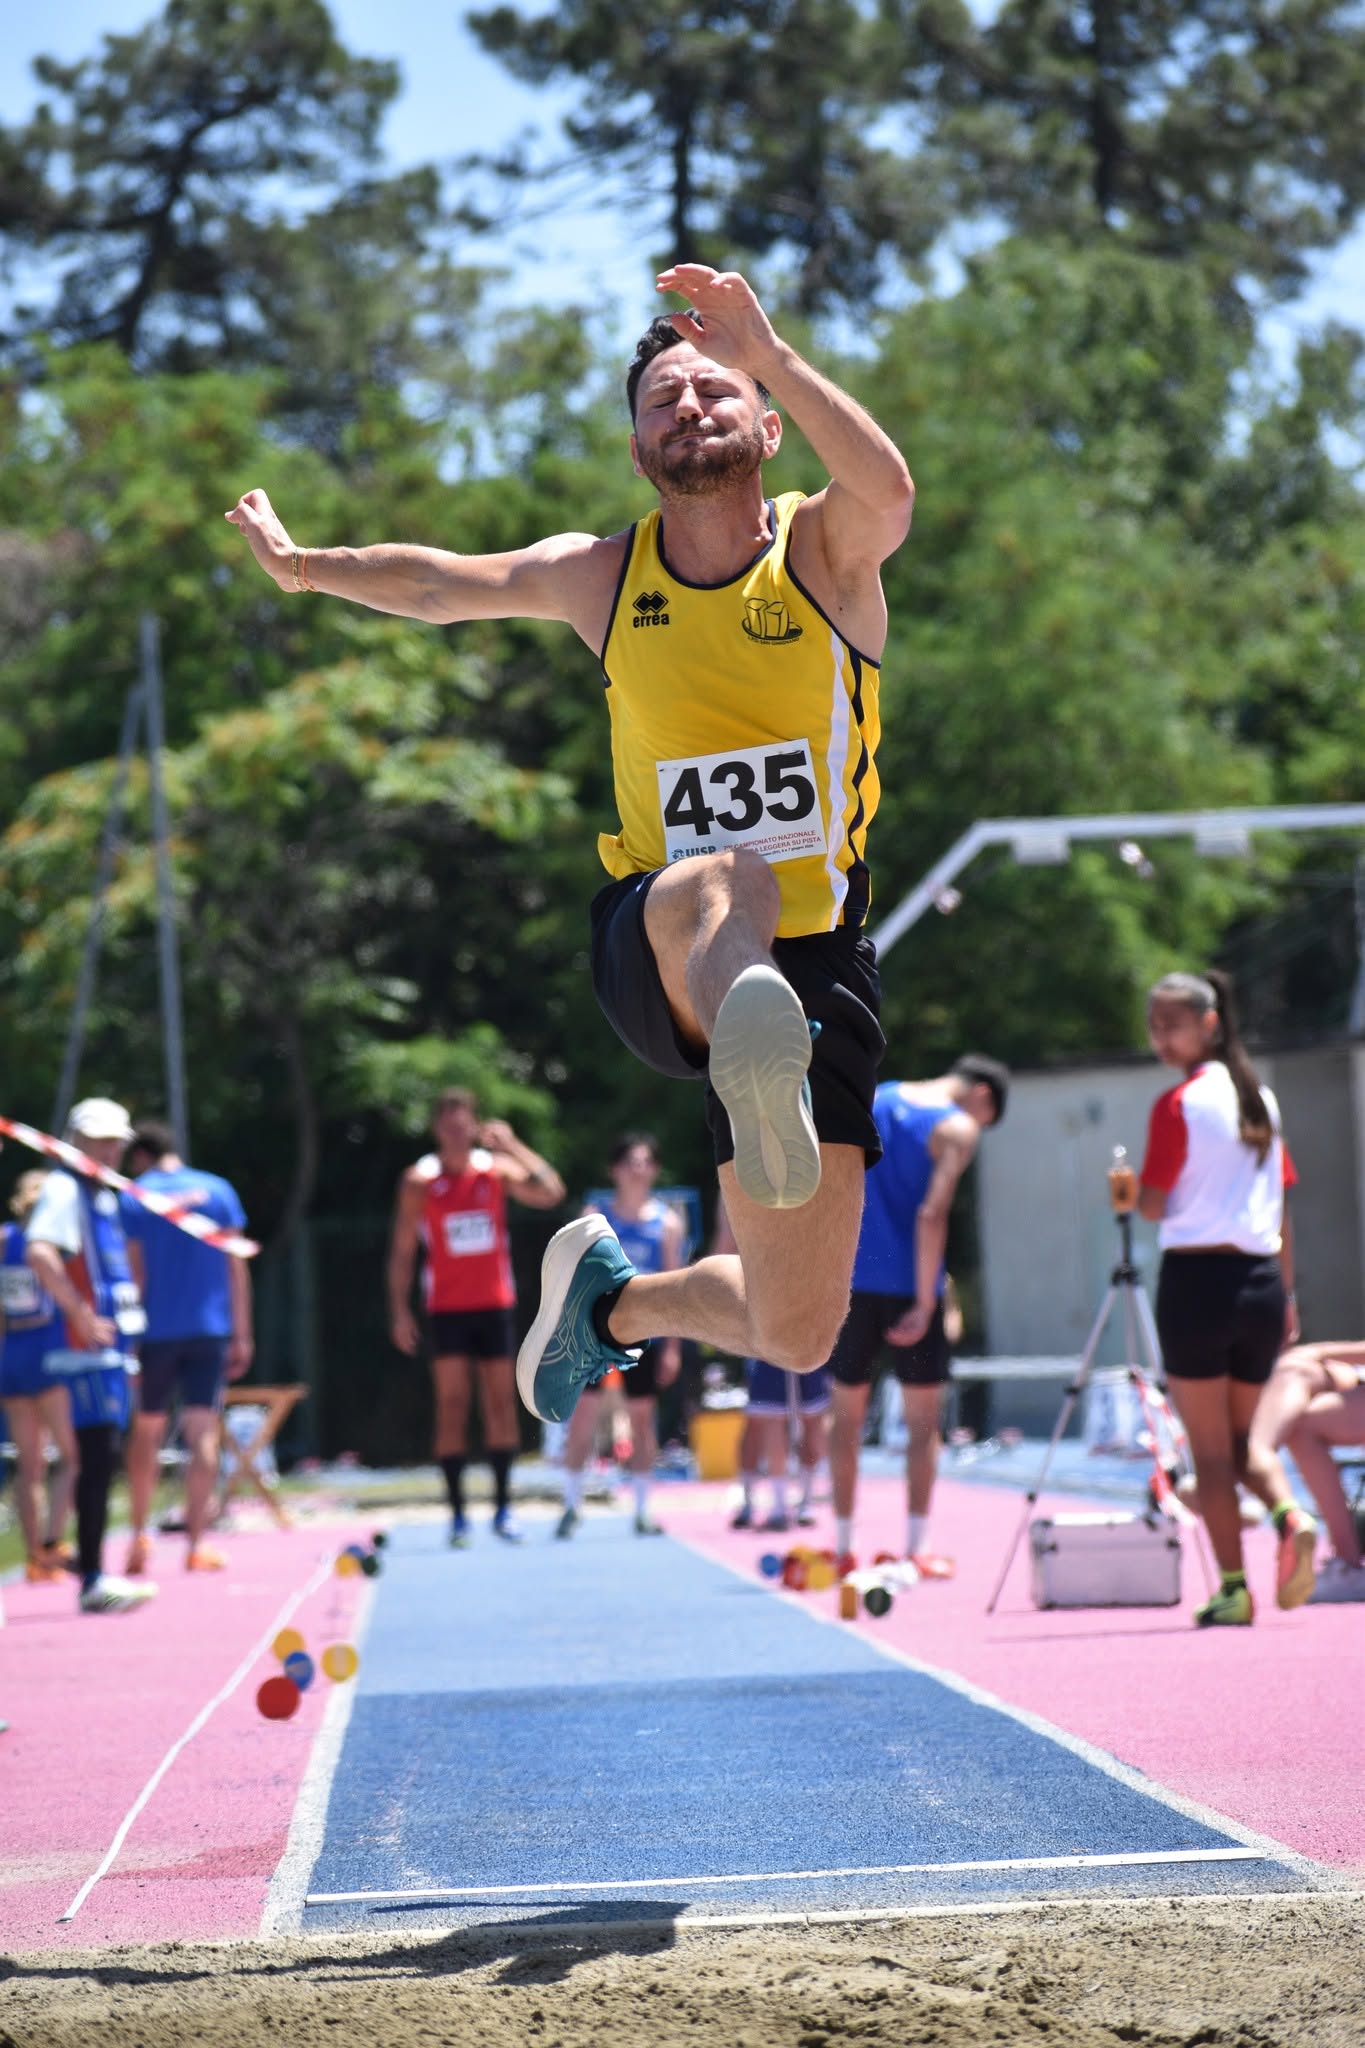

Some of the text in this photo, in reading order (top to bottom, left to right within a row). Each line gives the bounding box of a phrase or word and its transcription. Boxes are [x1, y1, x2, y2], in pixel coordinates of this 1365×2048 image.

[664, 750, 816, 837] 435
[734, 836, 778, 850] CAMPIONATO
[777, 829, 817, 841] NAZIONALE
[760, 841, 791, 853] LEGGERA
[791, 838, 802, 847] SU
[802, 835, 822, 844] PISTA
